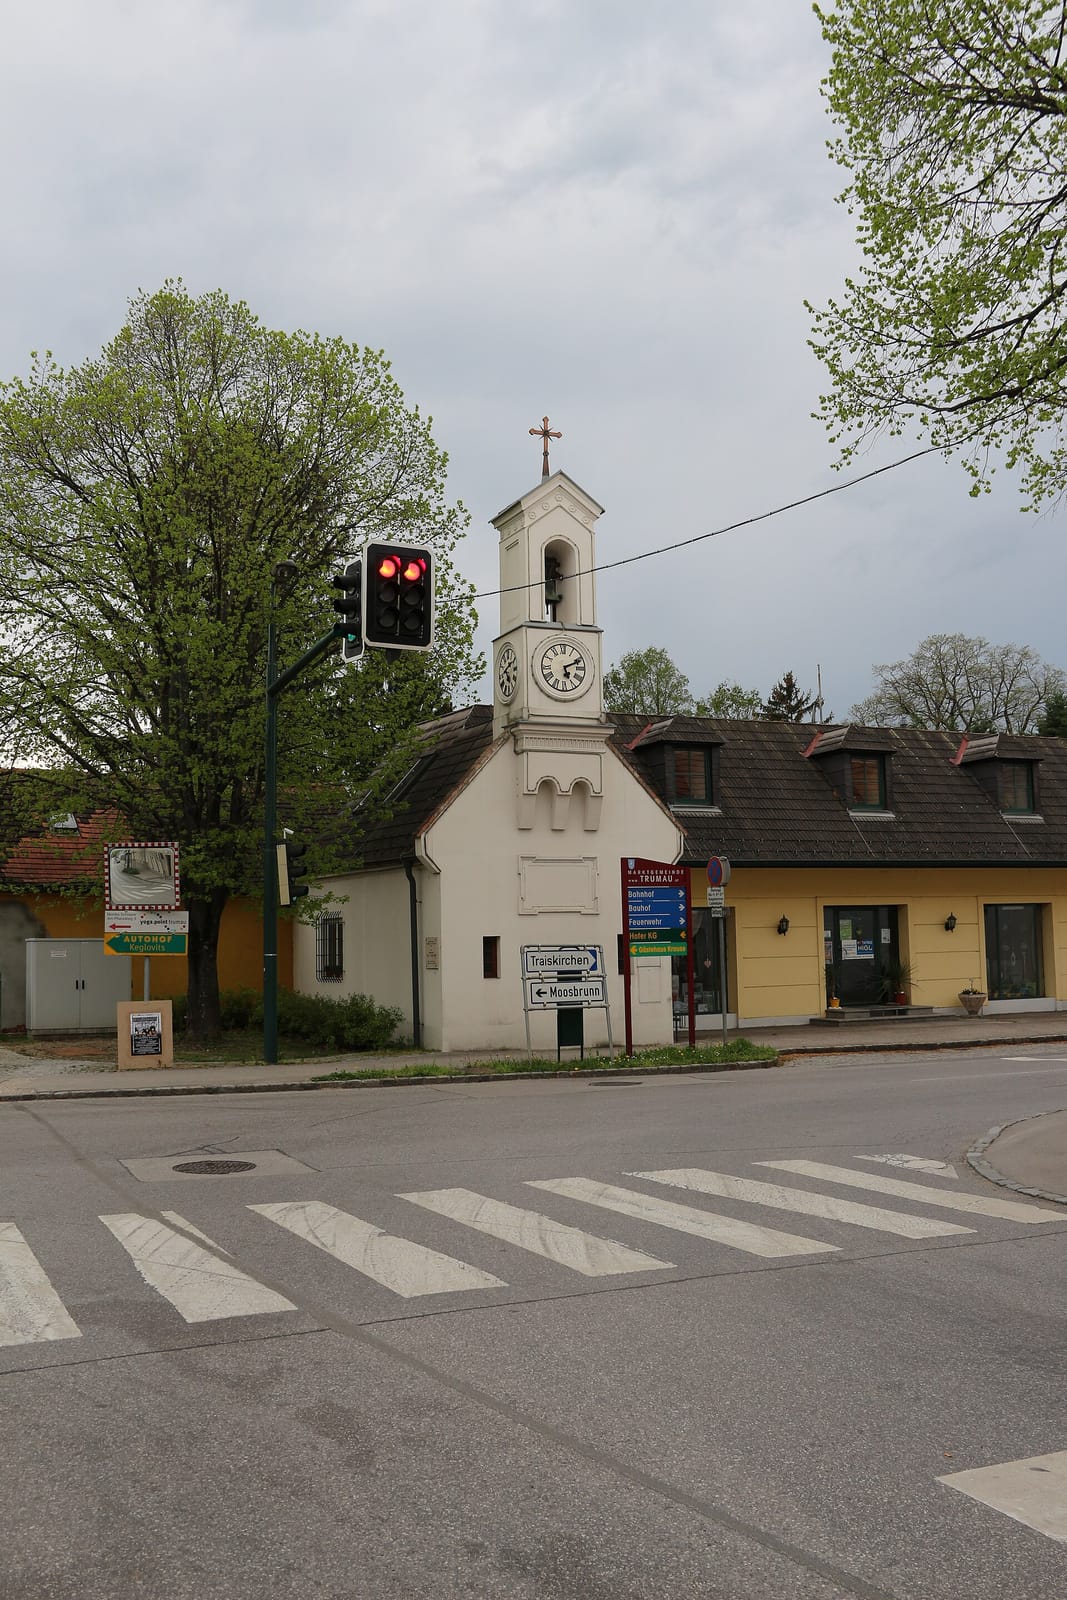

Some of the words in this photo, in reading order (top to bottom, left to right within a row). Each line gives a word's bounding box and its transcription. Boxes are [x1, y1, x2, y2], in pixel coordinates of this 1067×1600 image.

[628, 890, 655, 898] Bahnhof
[628, 904, 651, 912] Bauhof
[628, 918, 662, 926] Feuerwehr
[130, 944, 166, 952] Keglovits
[530, 954, 590, 966] Traiskirchen
[550, 986, 600, 998] Moosbrunn
